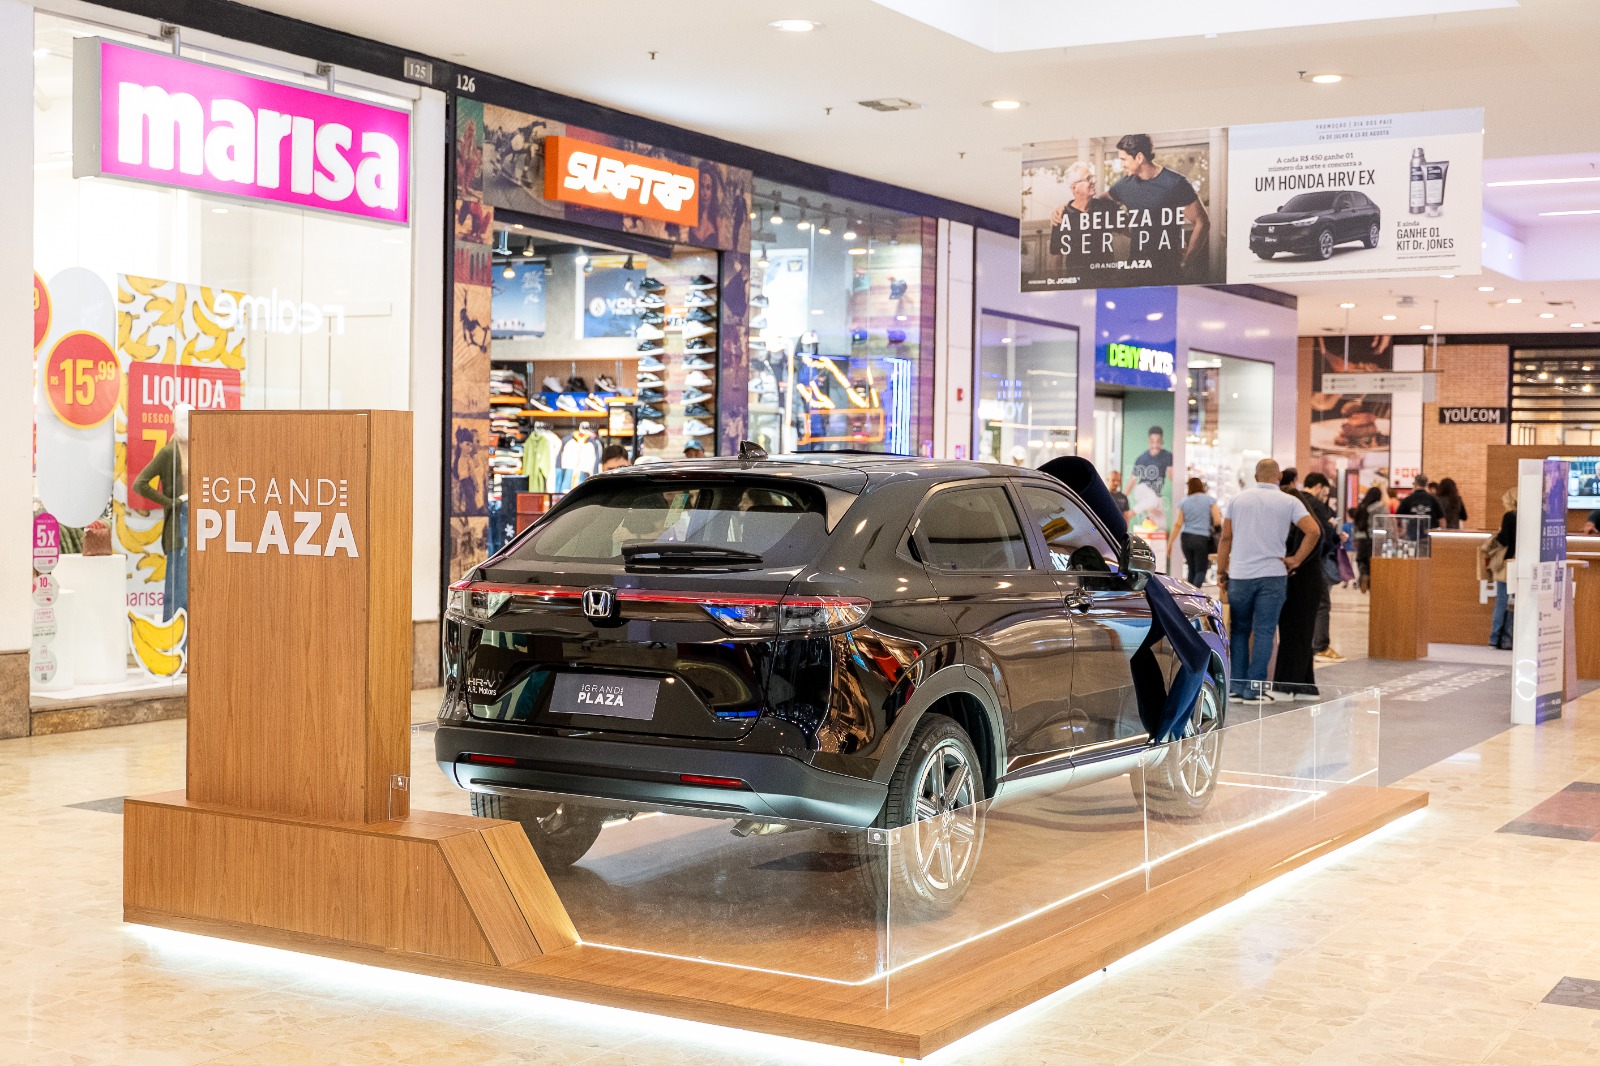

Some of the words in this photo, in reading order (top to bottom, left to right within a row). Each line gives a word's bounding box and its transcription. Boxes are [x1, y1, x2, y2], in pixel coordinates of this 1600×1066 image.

[409, 63, 427, 79] 125
[456, 74, 476, 93] 126
[117, 81, 400, 212] marisa
[1283, 156, 1299, 164] cada
[1323, 152, 1344, 162] ganhe
[1295, 163, 1303, 171] da
[1304, 162, 1321, 170] sorte
[1255, 176, 1275, 192] UM
[1278, 173, 1325, 191] HONDA
[1328, 170, 1356, 188] HRV
[1359, 169, 1375, 186] EX
[1060, 213, 1072, 232] A
[1079, 208, 1153, 231] BELEZA
[1161, 206, 1185, 226] DE
[1396, 227, 1427, 239] GANHE
[1429, 227, 1440, 238] 01
[1060, 232, 1114, 256] SER
[1138, 228, 1185, 252] PAI
[1396, 240, 1411, 251] KIT
[1412, 239, 1425, 250] Dr.
[1426, 238, 1454, 251] JONES
[142, 374, 226, 411] LIQUIDA
[1443, 406, 1501, 425] YOUCOM
[211, 476, 338, 507] GRAND
[196, 508, 359, 558] PLAZA
[126, 592, 165, 607] arisa
[467, 677, 497, 688] HR-V
[584, 684, 621, 695] GRAND
[478, 686, 497, 696] Motors
[577, 691, 624, 707] PLAZA
